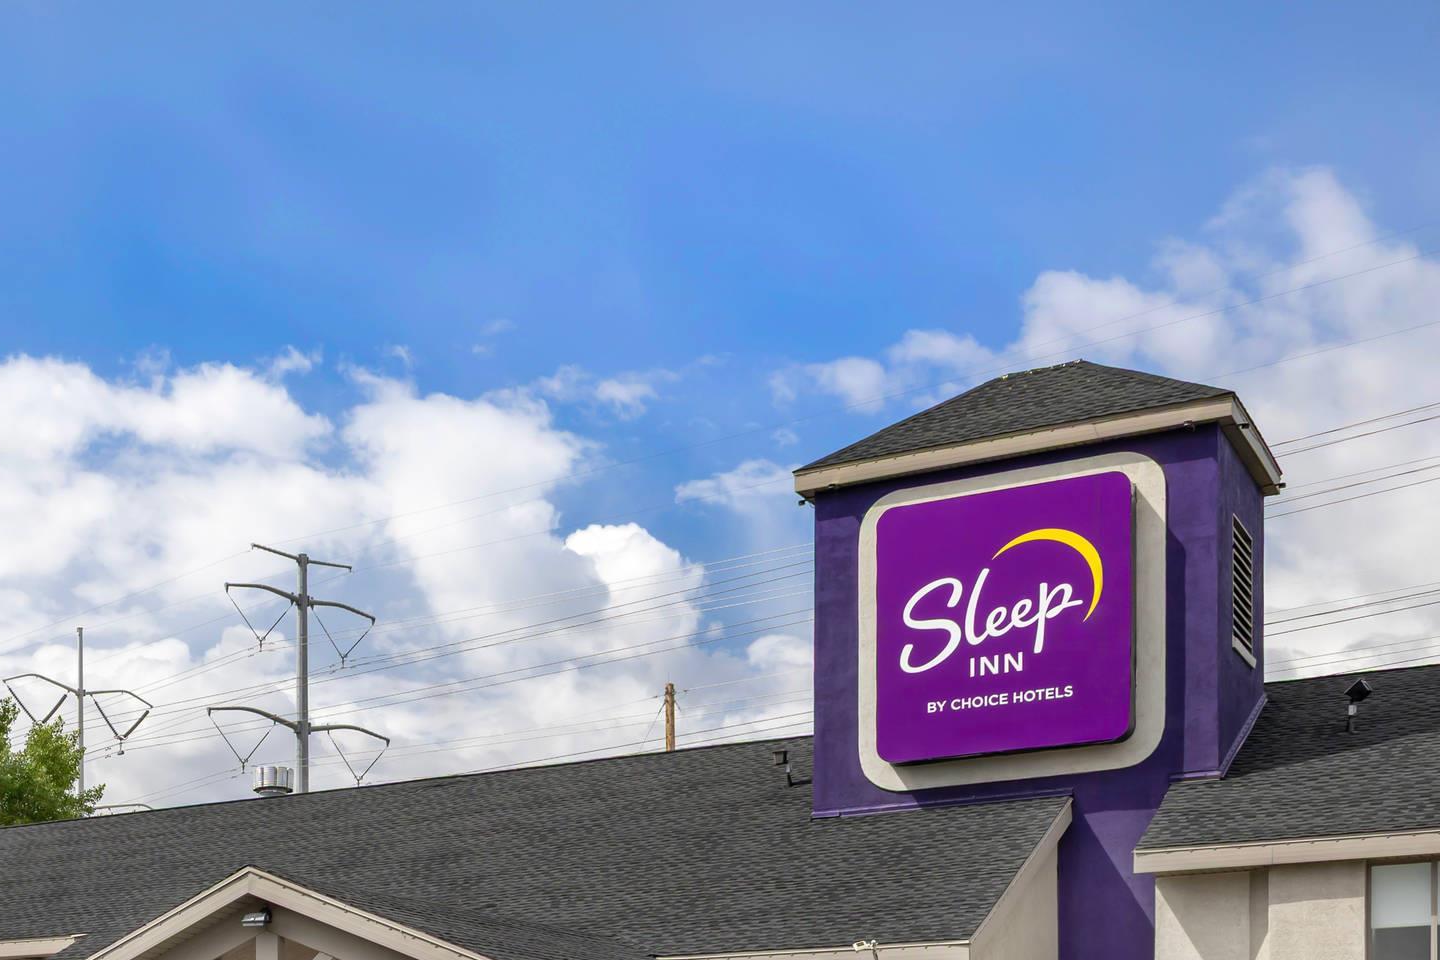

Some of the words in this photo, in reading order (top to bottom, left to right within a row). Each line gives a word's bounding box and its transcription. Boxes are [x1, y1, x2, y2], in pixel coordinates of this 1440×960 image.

[899, 567, 1084, 675] Sleep
[969, 651, 1024, 678] INN
[927, 700, 947, 713] BY
[950, 693, 1009, 711] CHOICE
[1013, 685, 1074, 703] HOTELS
